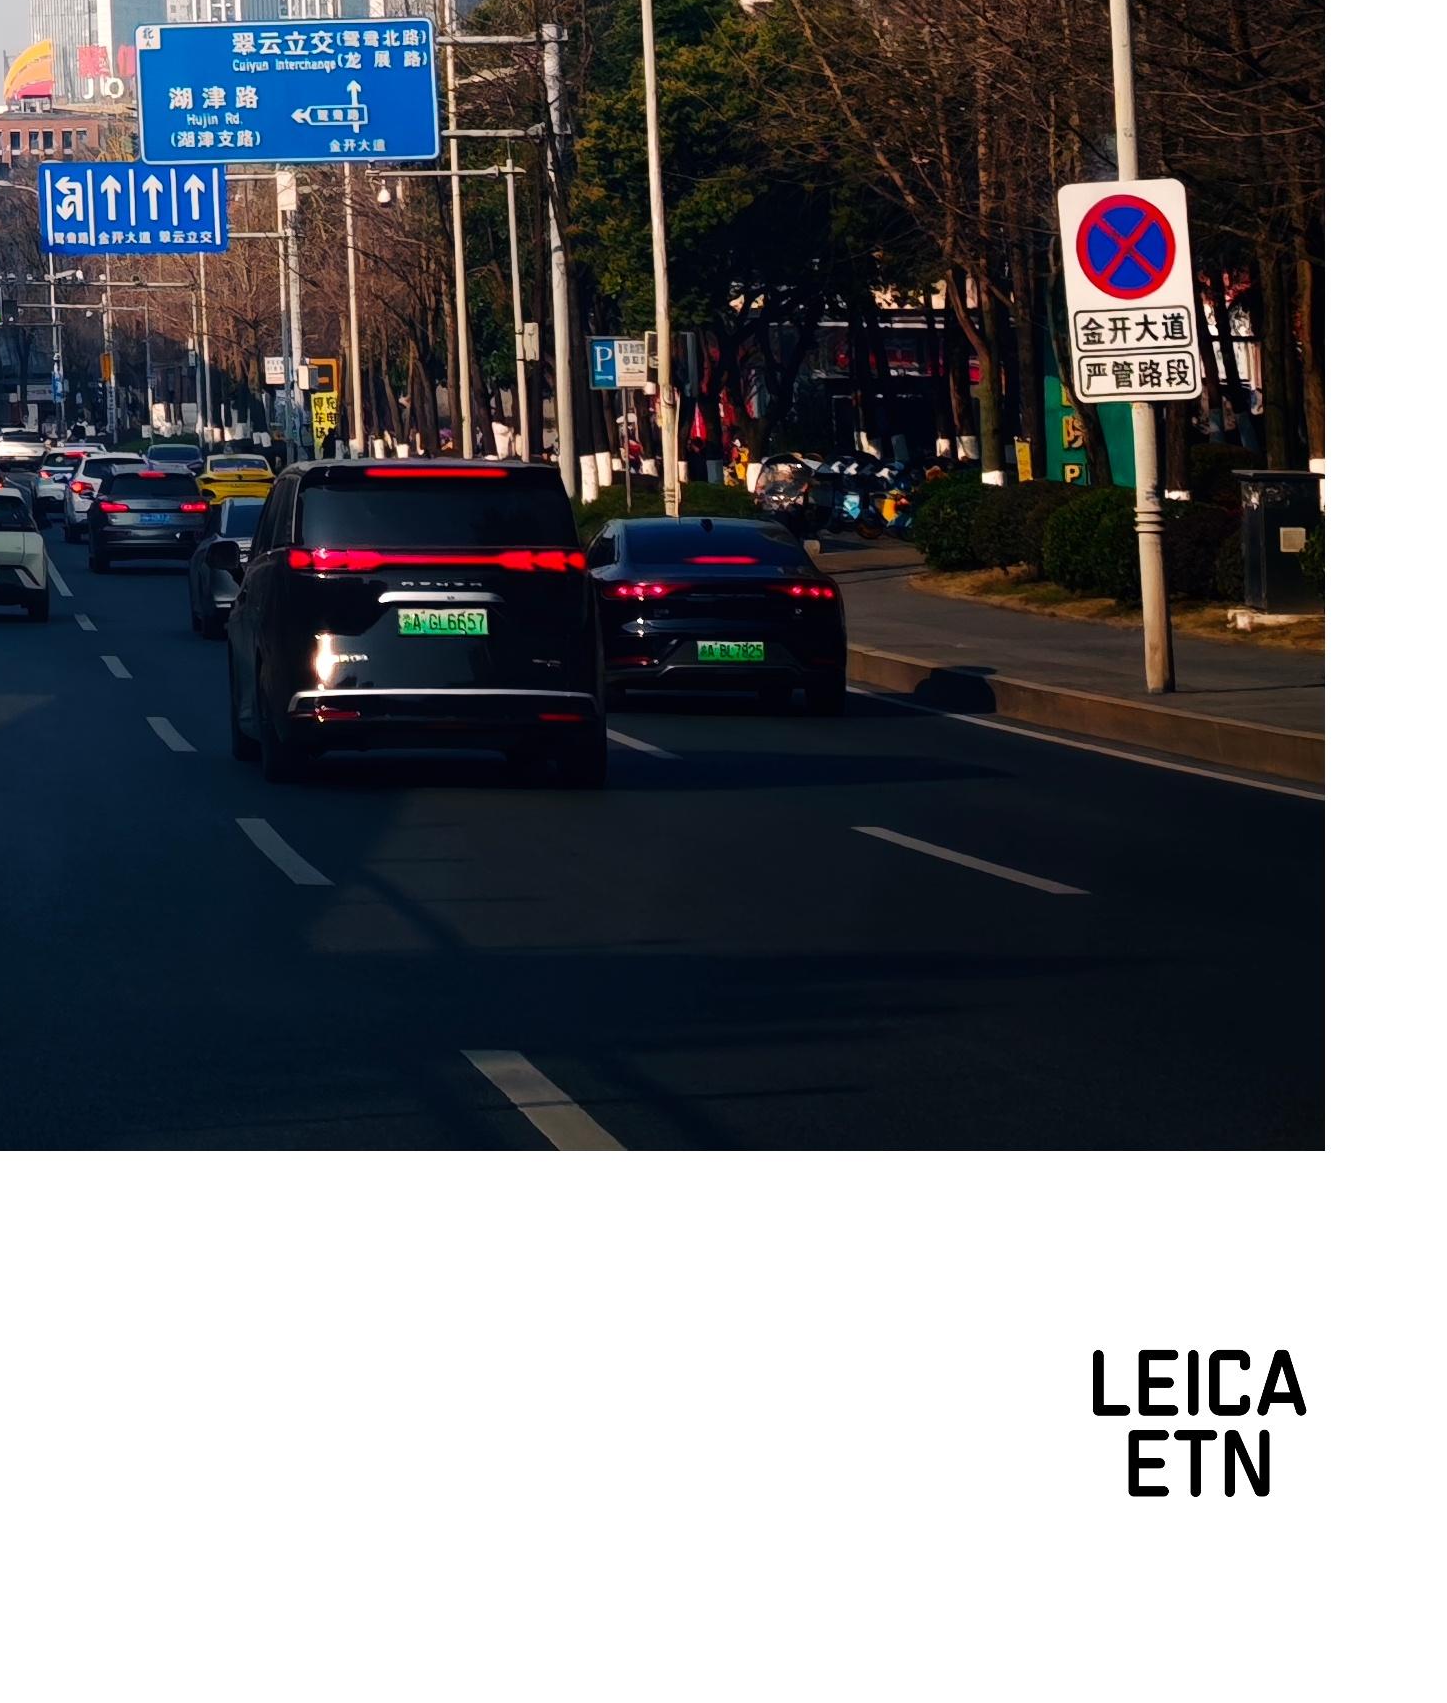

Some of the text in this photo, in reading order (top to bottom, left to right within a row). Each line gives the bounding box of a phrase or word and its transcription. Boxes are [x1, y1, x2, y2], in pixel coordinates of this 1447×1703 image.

[232, 31, 335, 56] 翠云立交
[275, 58, 337, 74] Interchange
[186, 112, 218, 126] Hujin
[1080, 312, 1188, 345] 金开大道
[594, 345, 613, 372] P
[1084, 358, 1192, 389] 严管路段
